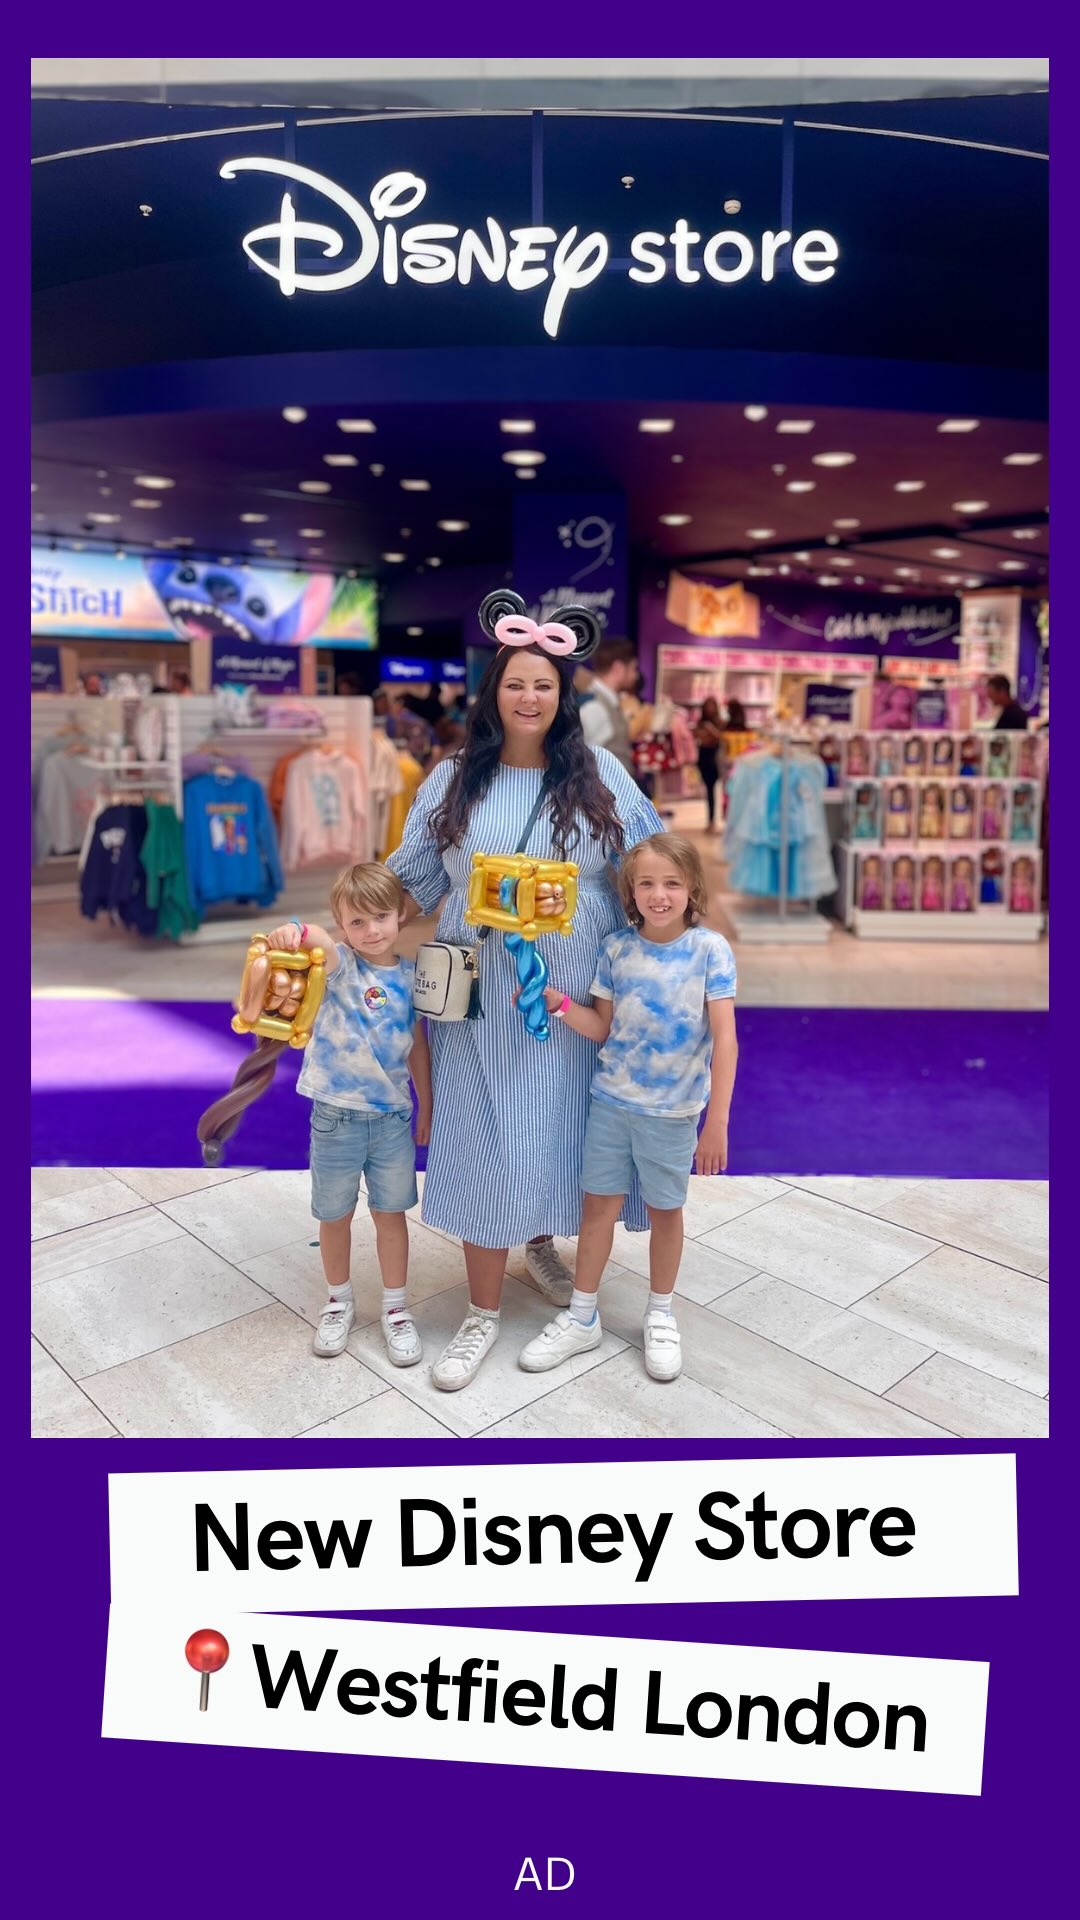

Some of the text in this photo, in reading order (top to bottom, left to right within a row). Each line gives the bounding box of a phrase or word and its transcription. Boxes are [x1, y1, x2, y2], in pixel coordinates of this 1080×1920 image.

[219, 157, 839, 337] Disney store
[422, 980, 437, 990] BAG
